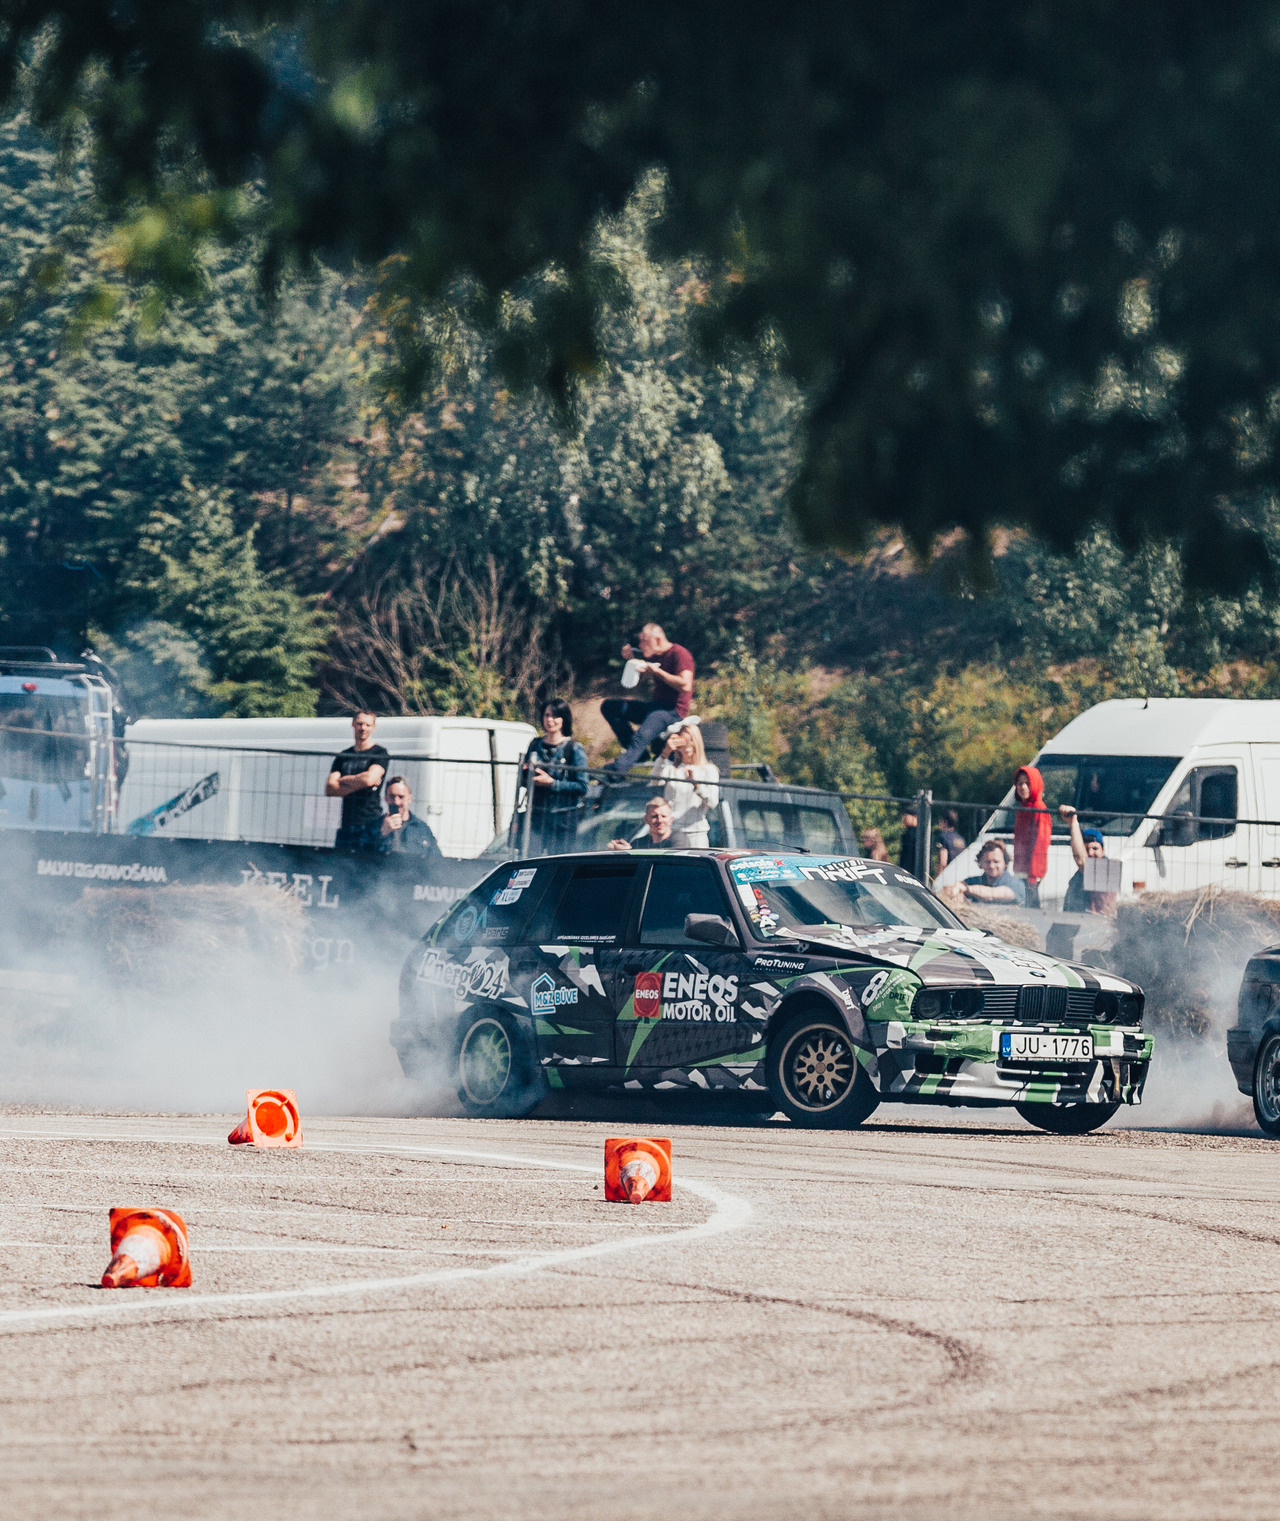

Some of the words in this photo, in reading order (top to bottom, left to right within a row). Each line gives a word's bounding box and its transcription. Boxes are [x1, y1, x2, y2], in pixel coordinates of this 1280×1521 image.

[754, 957, 805, 970] PROTUNING
[635, 989, 659, 1000] ENEOS
[663, 972, 739, 1002] ENEOS
[861, 970, 890, 1007] 8
[663, 1003, 711, 1021] MOTOR
[715, 1006, 738, 1023] OIL
[1015, 1036, 1090, 1057] JU-1776
